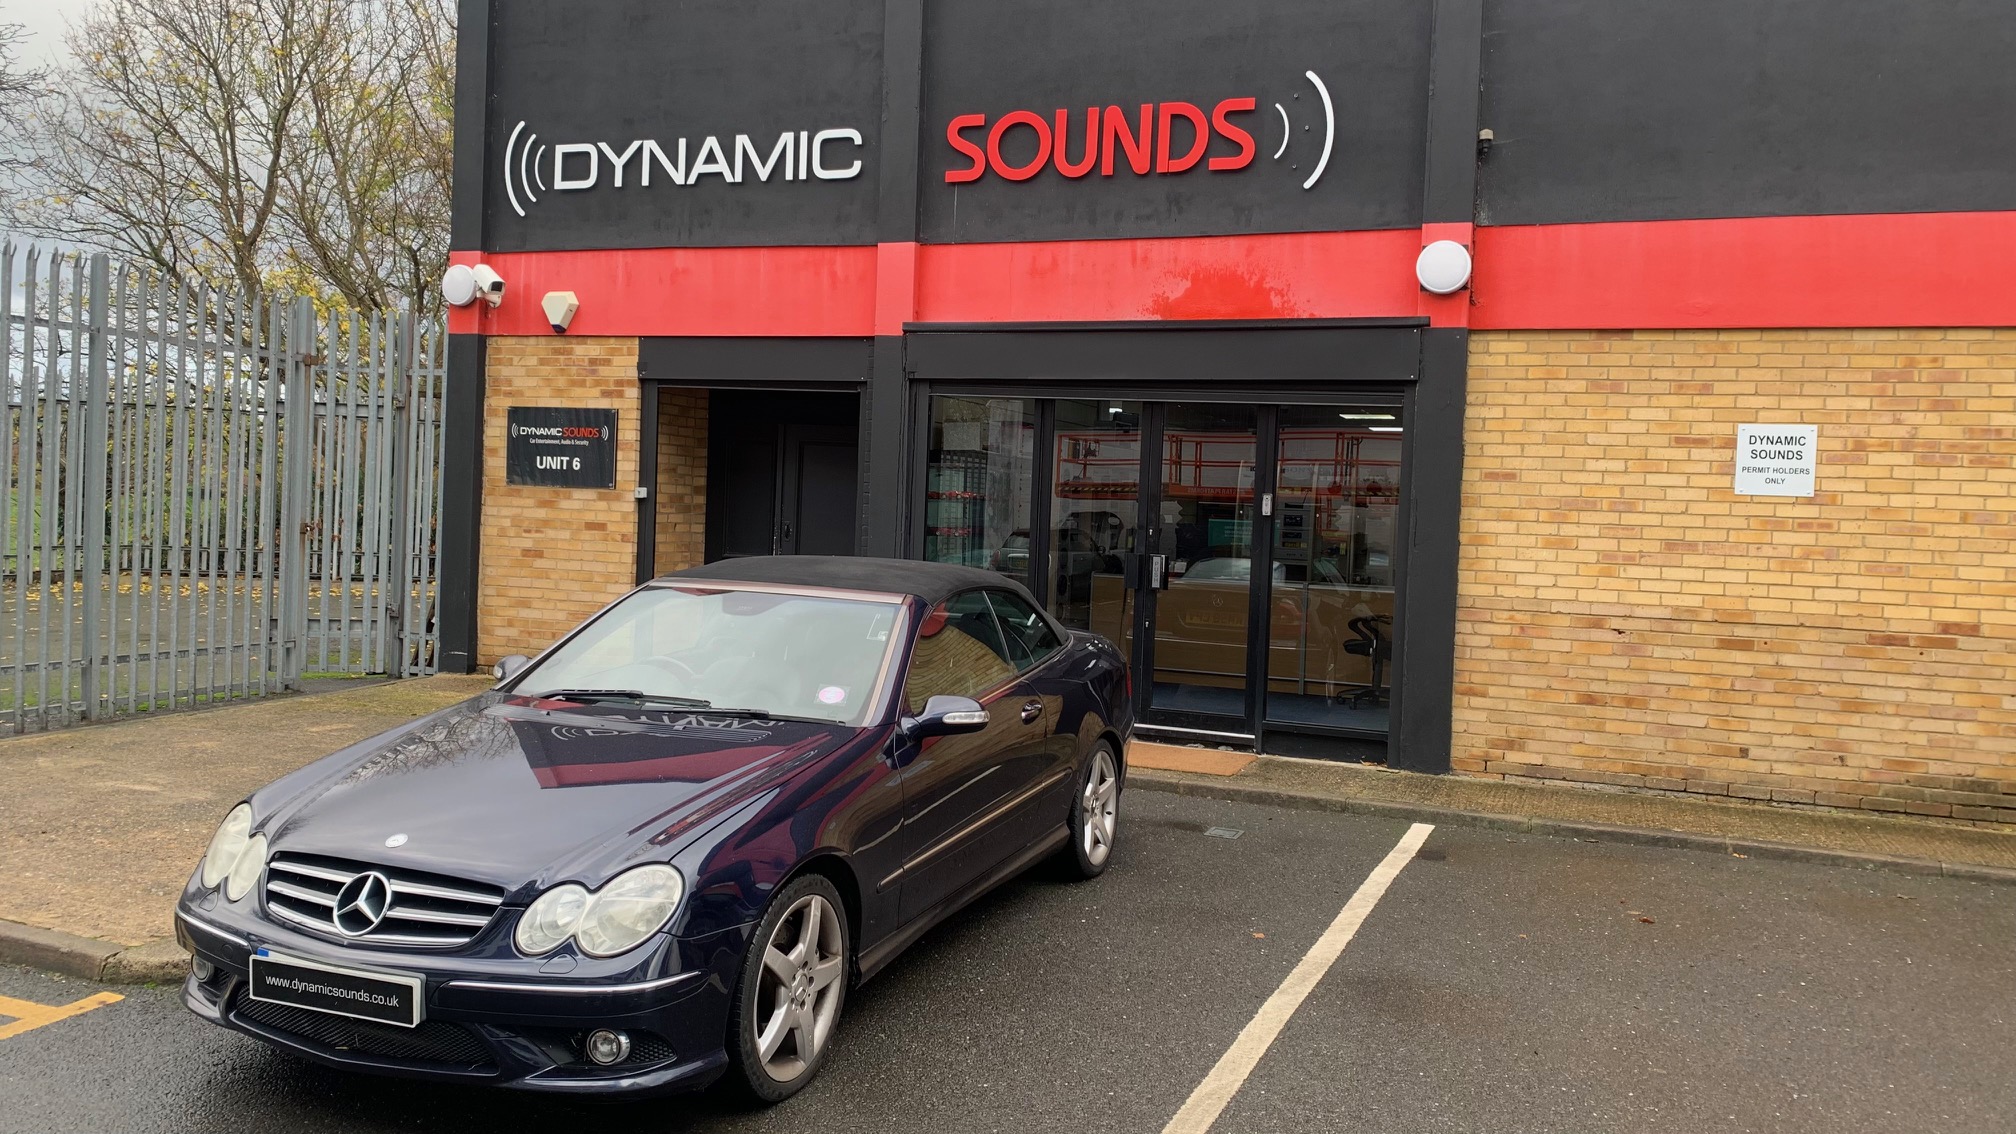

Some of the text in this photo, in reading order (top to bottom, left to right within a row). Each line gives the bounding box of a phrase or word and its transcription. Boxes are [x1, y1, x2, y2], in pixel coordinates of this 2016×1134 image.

[553, 97, 1257, 191] DYNAMIC SOUNDS
[520, 427, 599, 438] DYNAMIC SOUNDS
[1749, 435, 1806, 446] DYNAMIC
[1750, 449, 1803, 460] SOUNDS
[536, 456, 581, 471] UNIT 6
[1742, 466, 1810, 475] PERMIT HOLDERS
[265, 975, 399, 1007] www.dynamicsounds.co.uk
